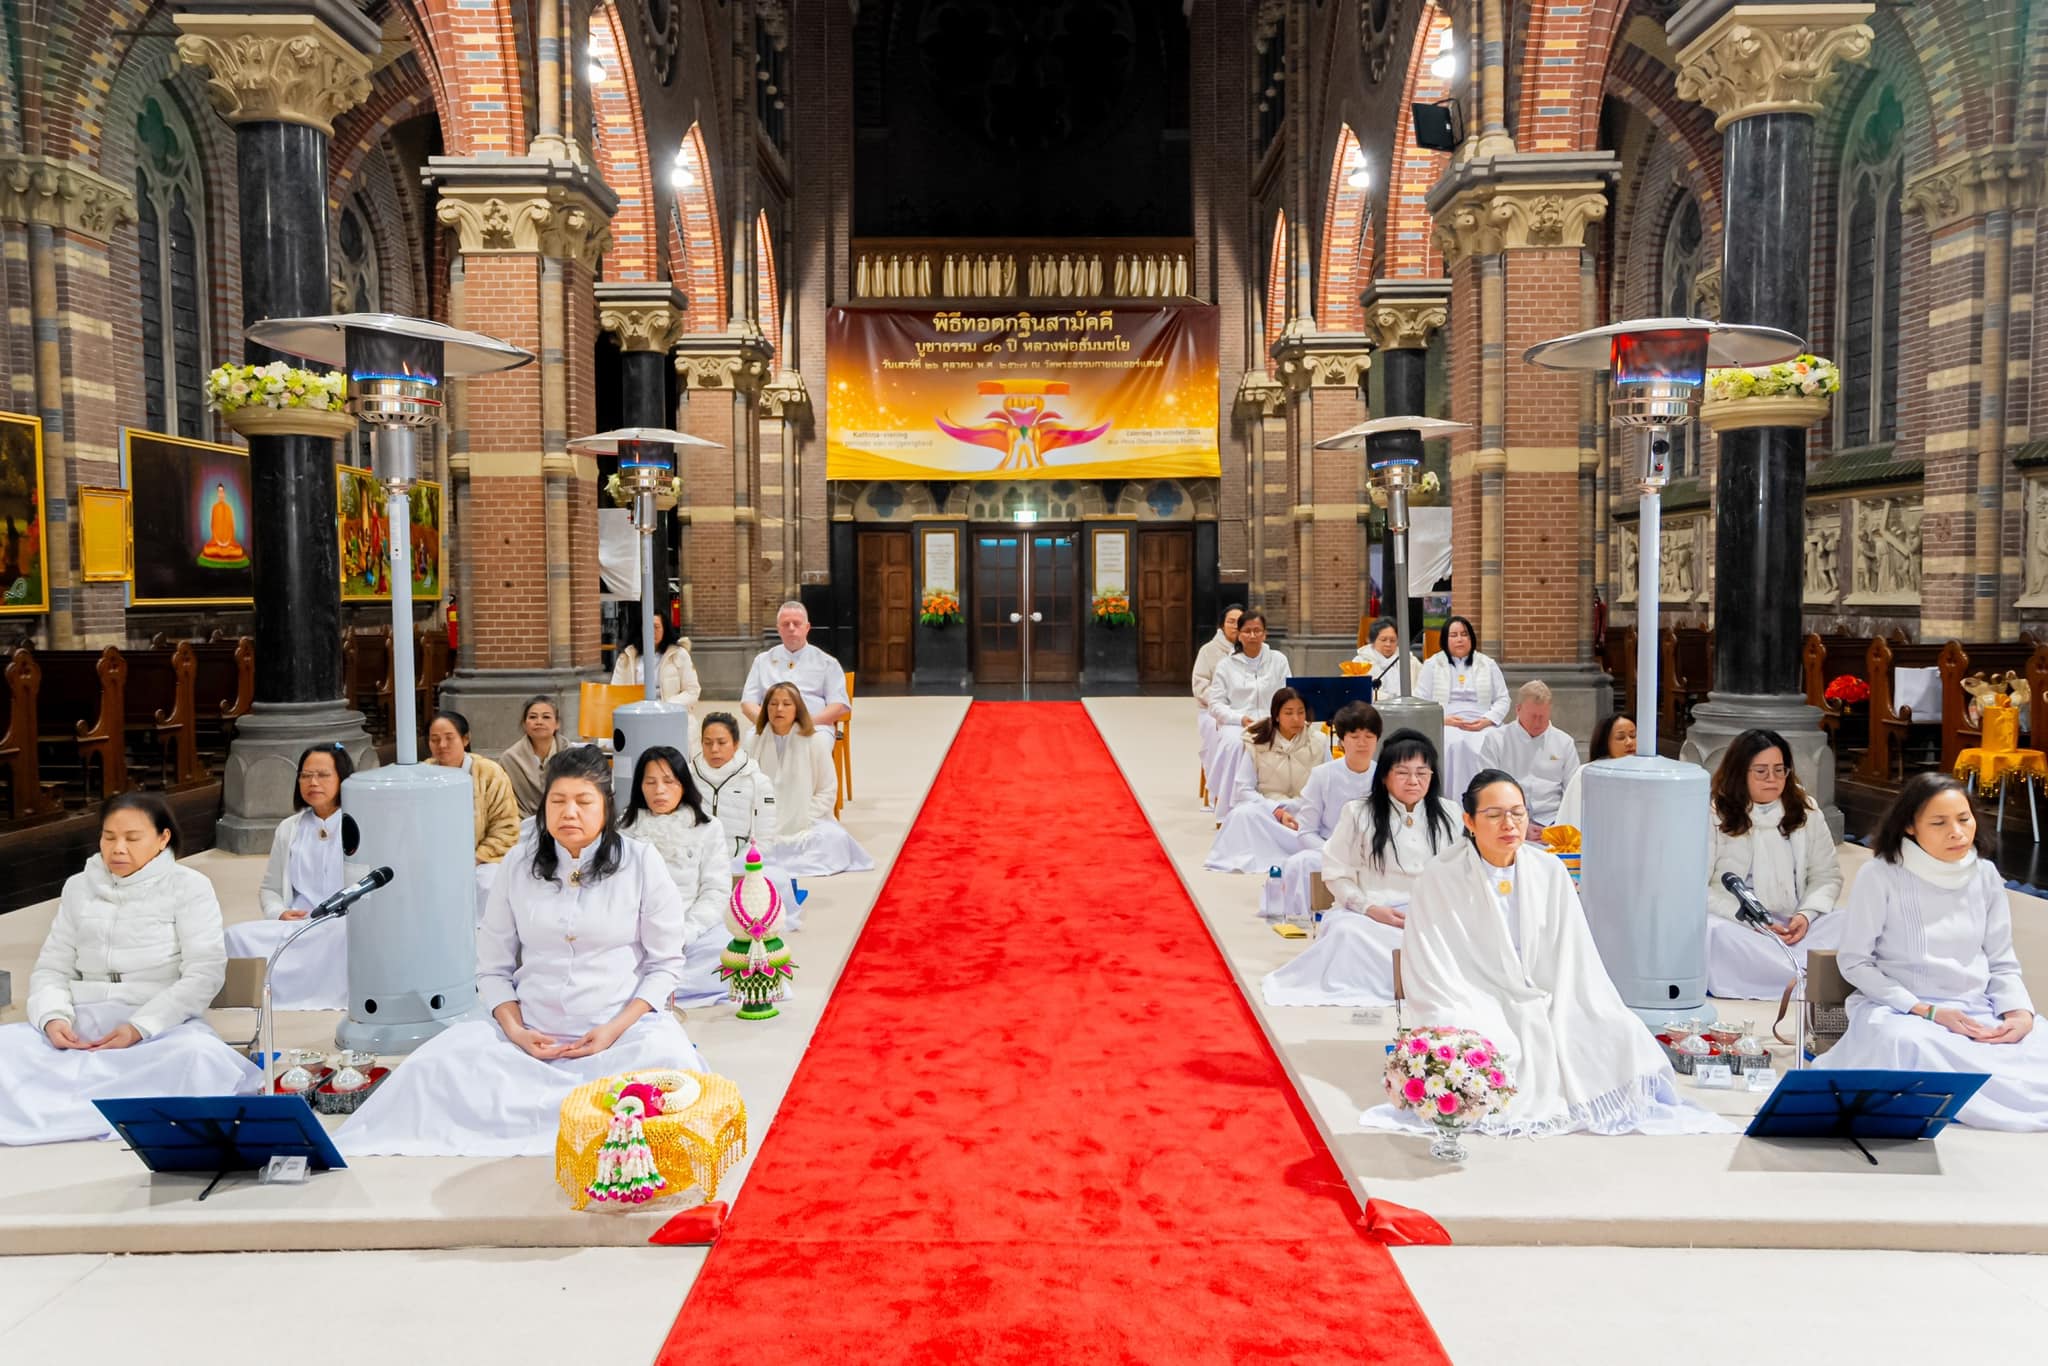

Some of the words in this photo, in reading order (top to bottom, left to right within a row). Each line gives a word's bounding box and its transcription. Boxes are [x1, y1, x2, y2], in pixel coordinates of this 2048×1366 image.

[933, 311, 1113, 338] พิธีทอดกฐินสามัคคี
[915, 341, 977, 357] บูชาธรรม
[1006, 338, 1018, 352] ปี
[1023, 335, 1130, 352] หลวงพ่อธัมมชโย
